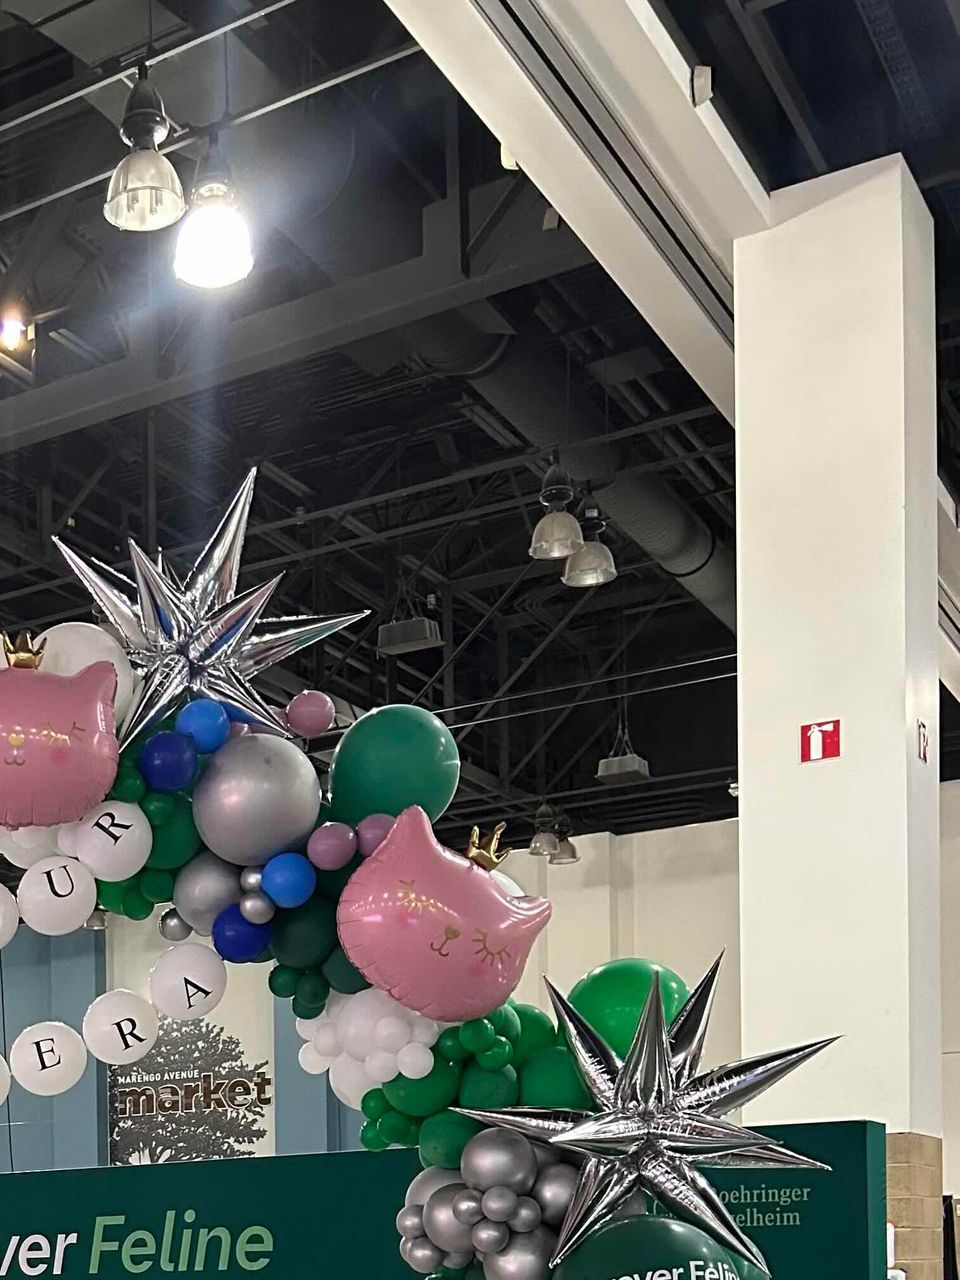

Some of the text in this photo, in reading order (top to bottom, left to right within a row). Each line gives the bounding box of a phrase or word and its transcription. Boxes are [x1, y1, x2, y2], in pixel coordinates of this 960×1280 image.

[117, 1069, 200, 1085] MARENGO AVENUE
[117, 1071, 272, 1118] market
[714, 1184, 811, 1206] oehringer
[734, 1207, 801, 1227] elheim
[88, 1209, 274, 1274] Feline
